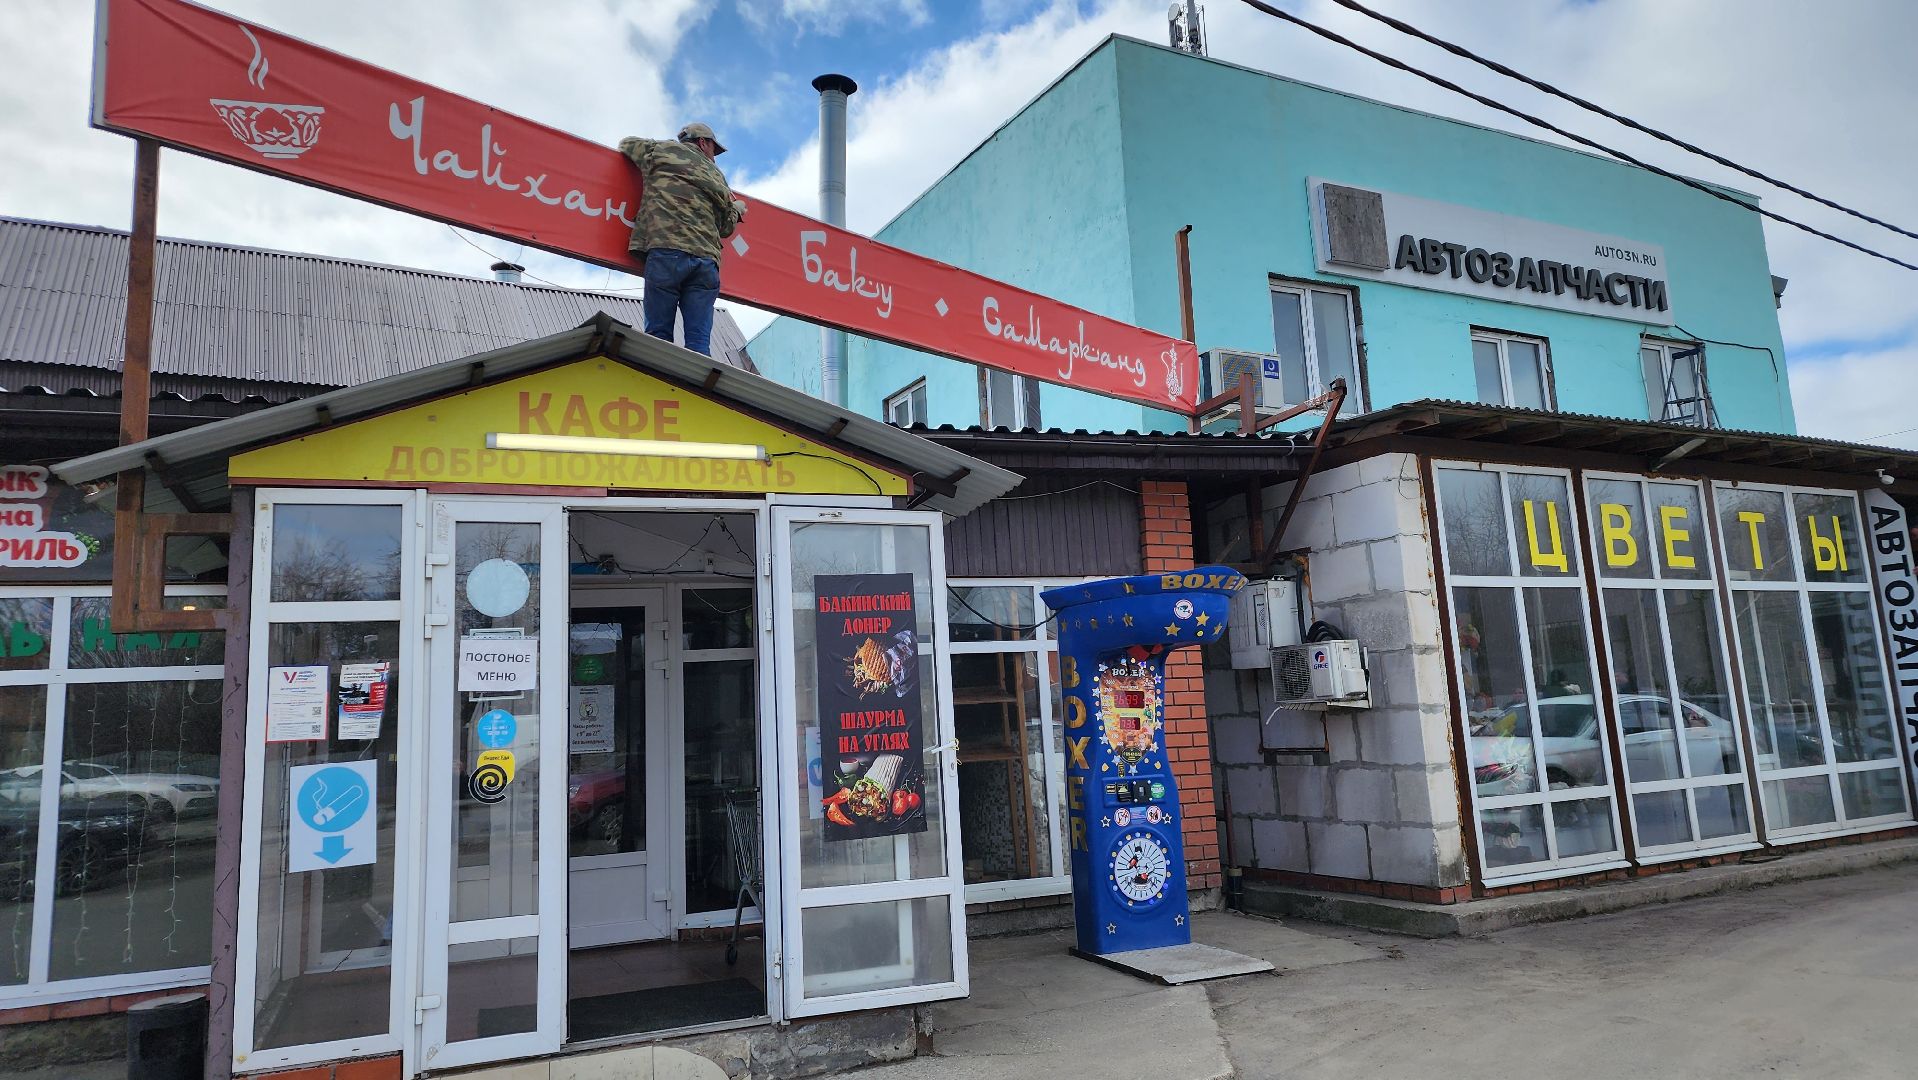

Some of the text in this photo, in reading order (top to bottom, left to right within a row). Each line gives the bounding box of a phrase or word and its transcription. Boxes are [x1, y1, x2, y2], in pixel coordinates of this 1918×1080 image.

[389, 96, 1147, 388] Чайхан Баку Самарканд
[1595, 245, 1657, 267] AUTO3N.RU
[1395, 234, 1669, 312] АВТОЗАПЧАСТИ
[518, 391, 681, 442] КАФЕ
[385, 445, 797, 488] ДОБРО ПОЖАЛОВАТЬ
[1523, 499, 1848, 573] ЦВЕТЫ
[1161, 573, 1248, 591] BOXER
[819, 592, 912, 613] БАКИНСКИЙ
[842, 617, 893, 636] ДОНЕР
[1870, 505, 1918, 770] АВТОЗАП
[465, 652, 531, 663] ПОСТОНОЕ
[477, 671, 517, 682] МЕНЮ
[1111, 667, 1147, 677] BOER
[840, 709, 906, 730] ШАУРМА
[838, 737, 860, 754] НА
[864, 731, 910, 752] УГЛЯХ
[1061, 655, 1091, 852] BOXER
